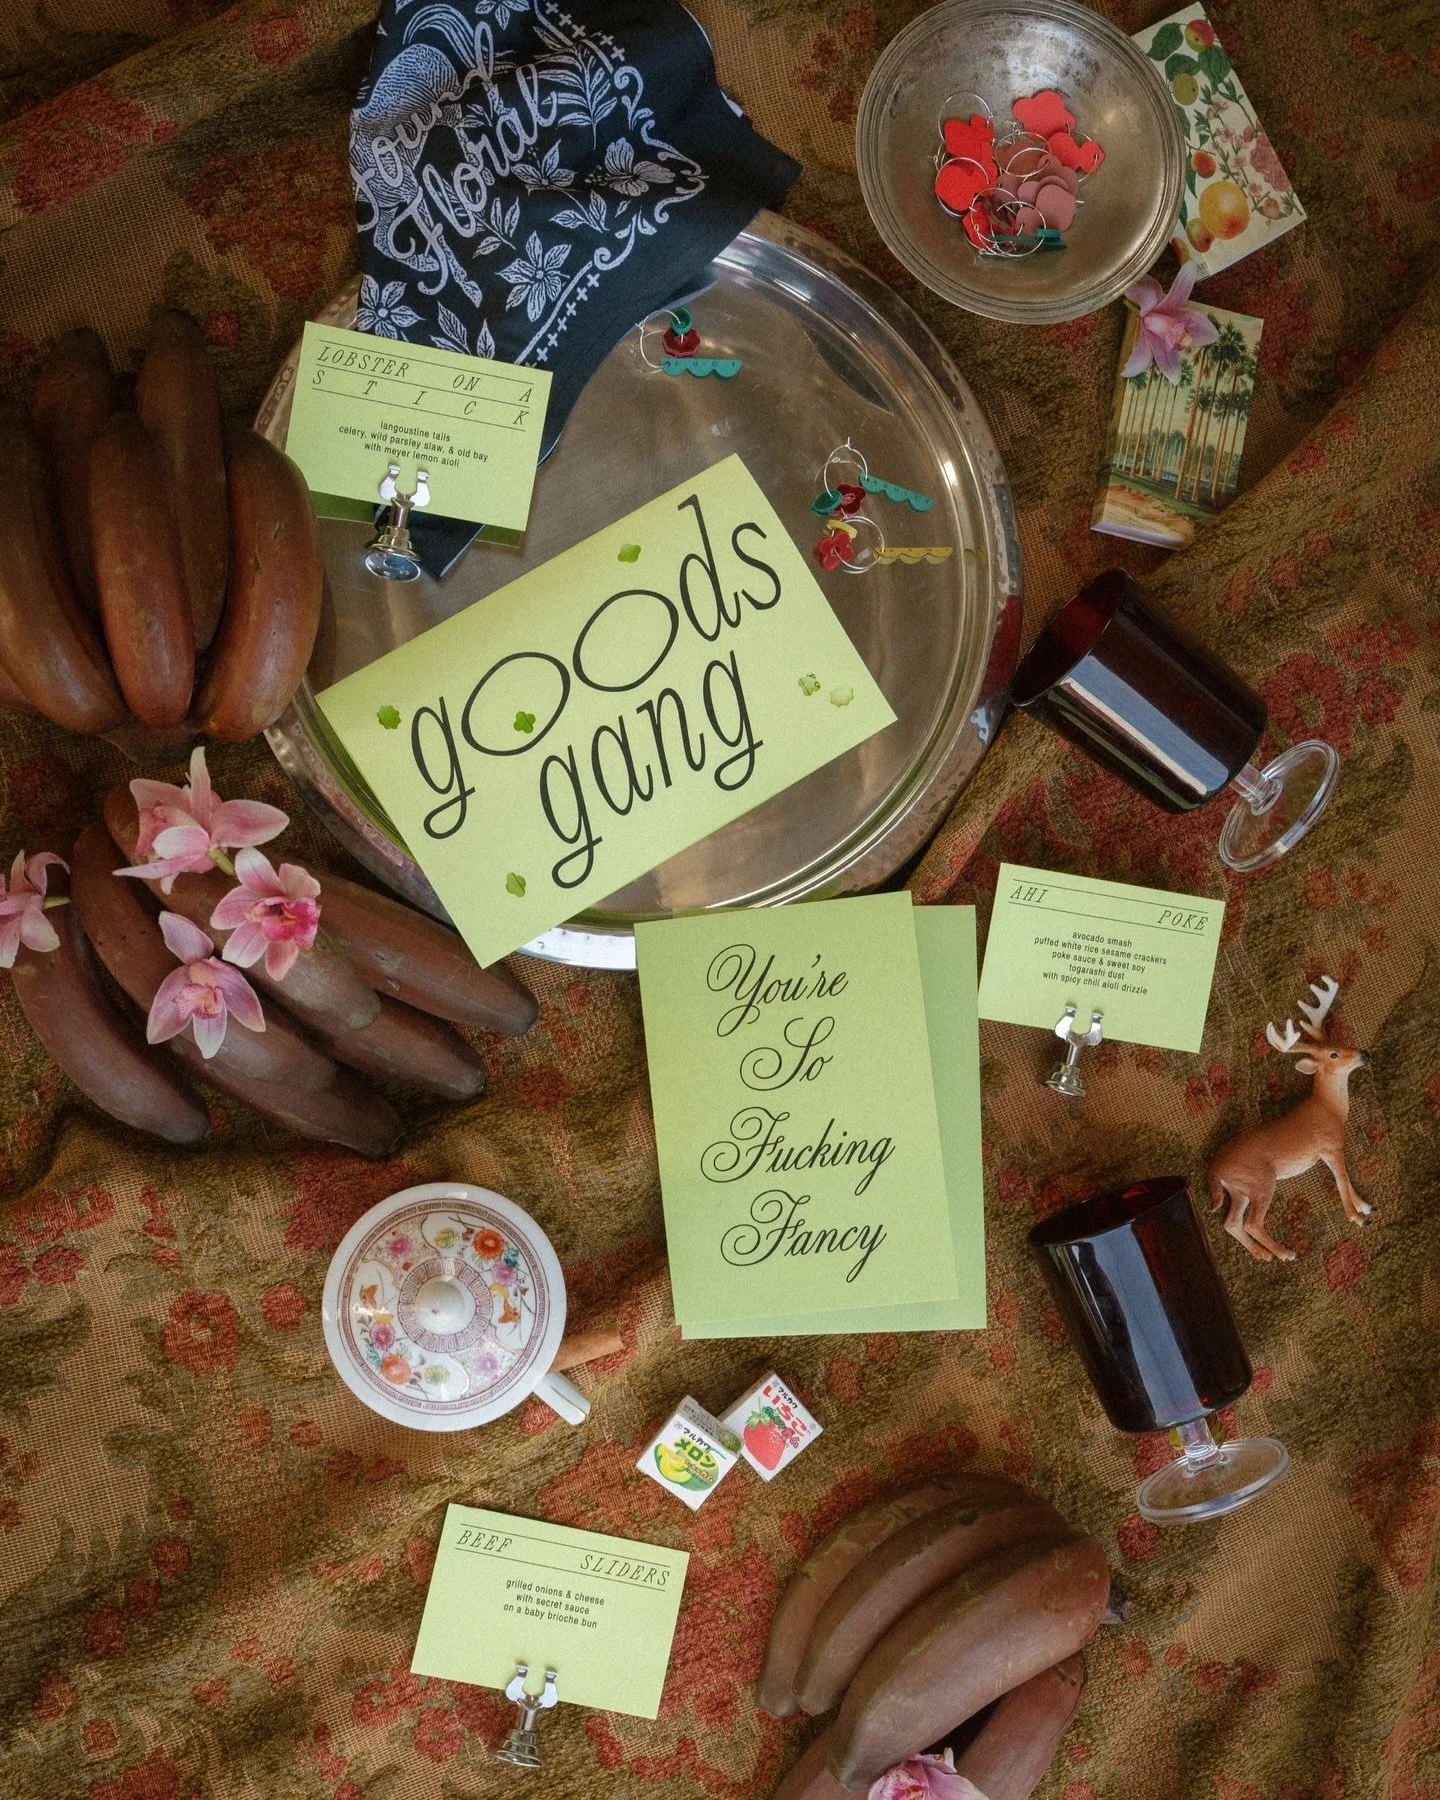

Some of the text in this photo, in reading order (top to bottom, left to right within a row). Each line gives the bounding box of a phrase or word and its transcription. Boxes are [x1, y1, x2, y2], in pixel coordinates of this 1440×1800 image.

[388, 63, 558, 296] Floral
[317, 345, 533, 403] LOBSTER ON A
[339, 425, 489, 464] celery, wild parsley slaw, & old bay
[381, 419, 451, 443] langoustine tails
[365, 441, 460, 468] with meyer lemon aioli
[411, 494, 782, 839] goods
[539, 650, 764, 889] gang
[1010, 884, 1209, 931] AHI POKE
[1034, 936, 1168, 966] puffed white rice sesame crackers
[1072, 931, 1133, 949] avocado smash
[1052, 950, 1146, 975] poke sauce & sweet soy
[1069, 963, 1125, 981] togarashi dust
[706, 943, 849, 1037] You’re
[1043, 970, 1148, 996] with spicy chili aioli drizzle
[740, 1016, 835, 1091] So
[700, 1106, 896, 1196] Fucking
[720, 1189, 887, 1283] Fancy
[778, 1387, 798, 1409] マルカワ
[675, 1438, 716, 1468] メロン
[683, 1427, 712, 1450] マルカワ
[456, 1529, 670, 1587] BEEF SLIDERS
[506, 1579, 605, 1606] grilled onions & cheese
[517, 1592, 590, 1616] with secret sauce
[504, 1603, 598, 1629] on a baby brioche bun
